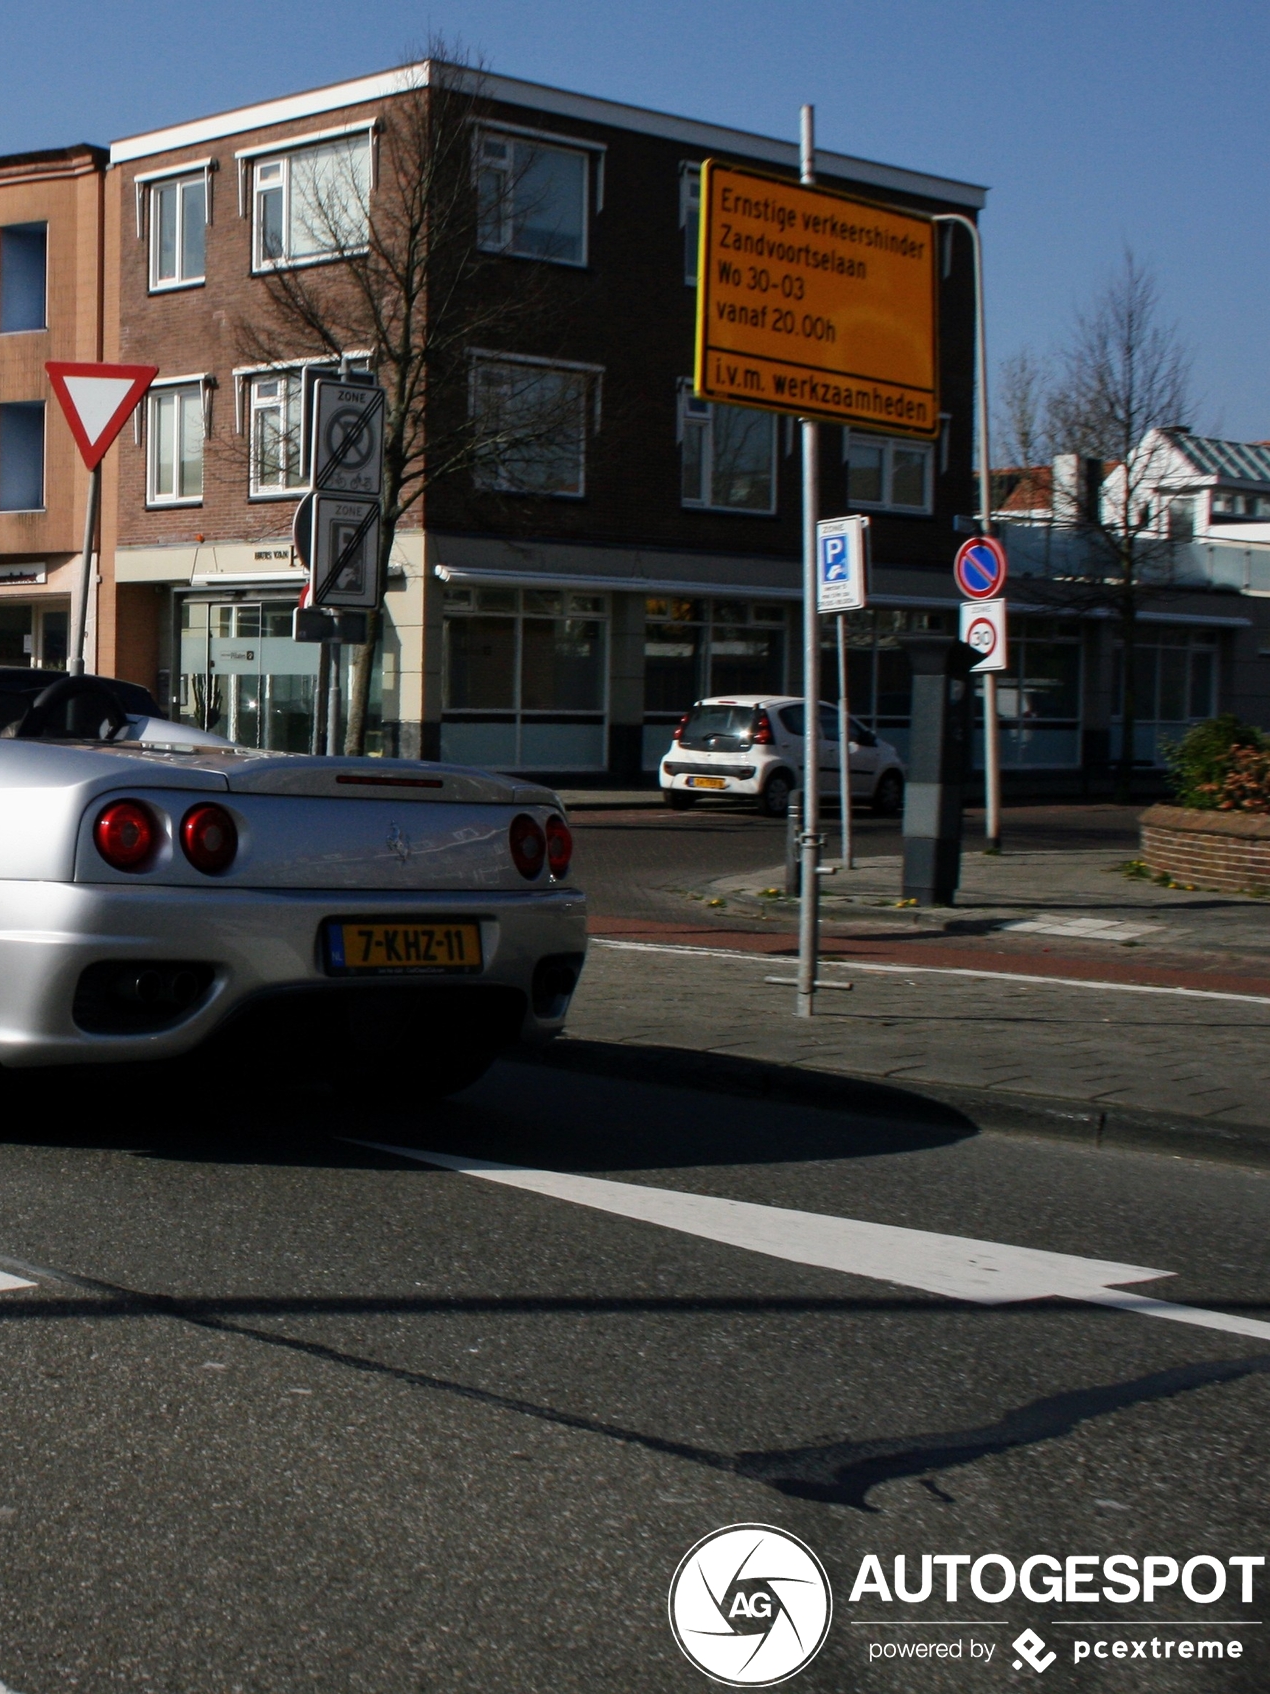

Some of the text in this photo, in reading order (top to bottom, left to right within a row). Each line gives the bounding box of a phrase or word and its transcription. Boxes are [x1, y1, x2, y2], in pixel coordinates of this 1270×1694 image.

[721, 188, 925, 260] Ernstige verkeershinder
[719, 224, 867, 279] Zandvoortselaan
[718, 260, 805, 300] Wo 30-03
[716, 301, 836, 343] vanaf 20.00h
[338, 391, 367, 404] ZONE
[715, 357, 927, 422] i.v.m. werkzaamheden
[335, 505, 362, 517] ZONE
[822, 524, 844, 534] ZONE
[254, 551, 272, 561] HUIS
[274, 550, 289, 559] VAN
[826, 539, 843, 563] P
[971, 605, 992, 614] ZONE
[972, 630, 991, 646] 30
[331, 950, 343, 962] NL
[358, 930, 465, 962] 7-KHZ-11
